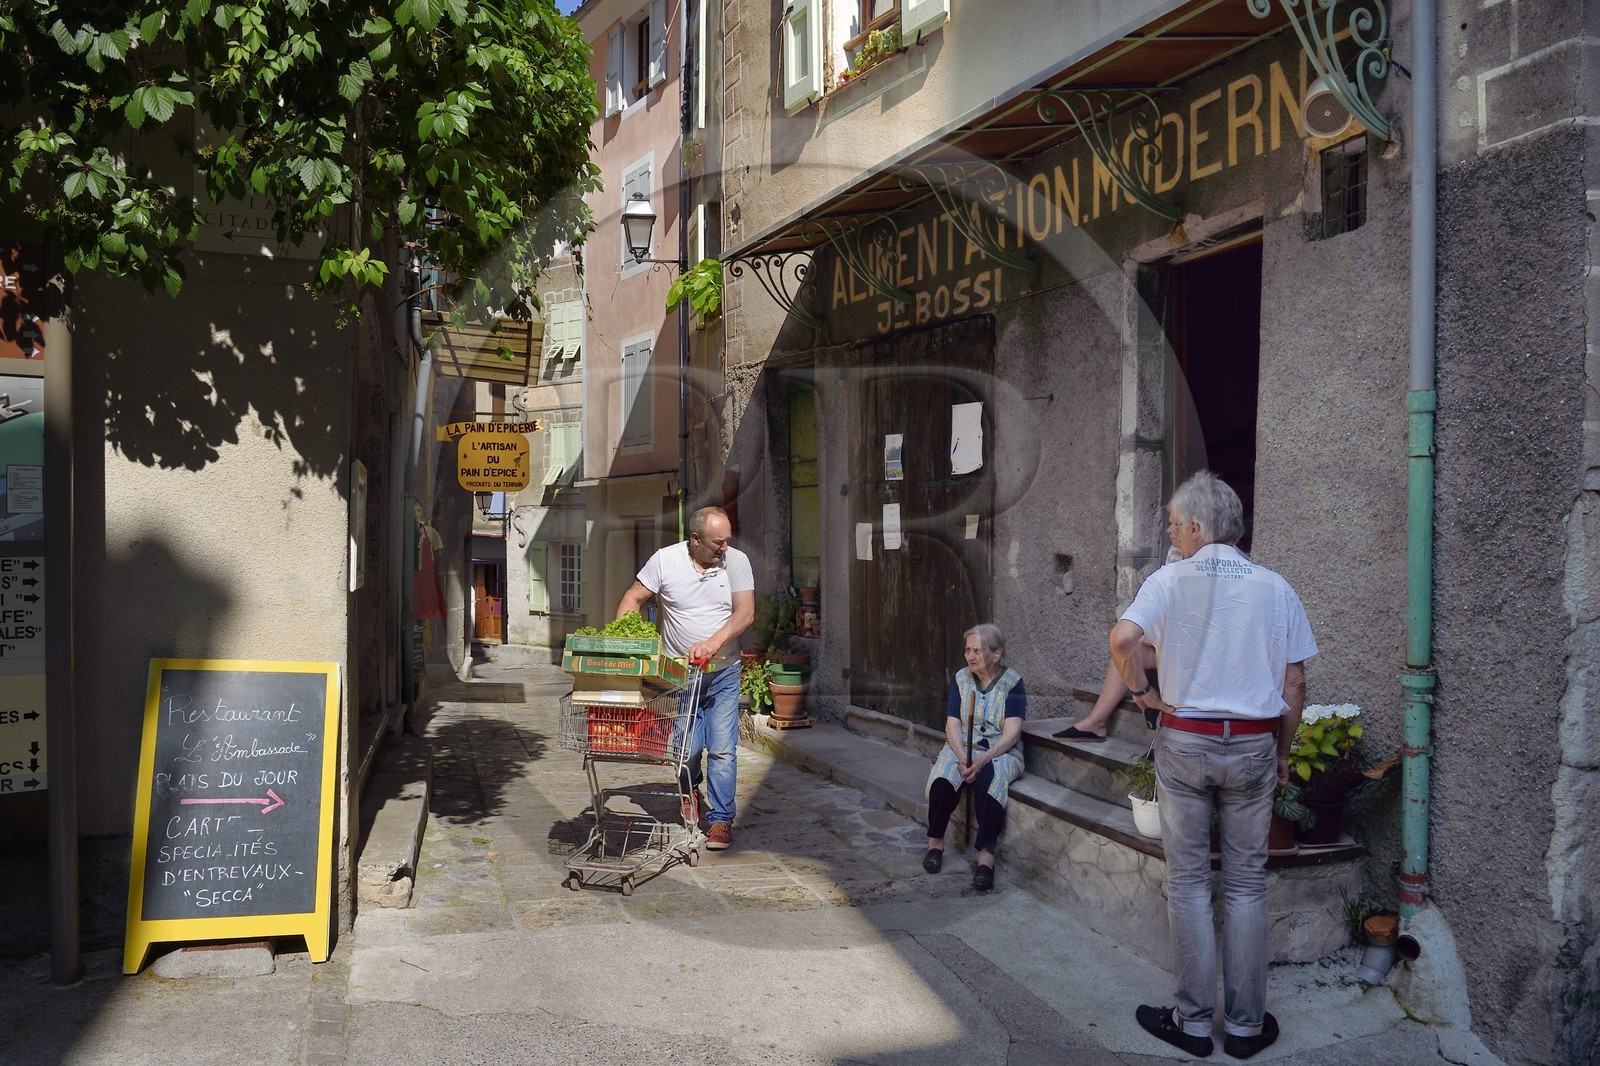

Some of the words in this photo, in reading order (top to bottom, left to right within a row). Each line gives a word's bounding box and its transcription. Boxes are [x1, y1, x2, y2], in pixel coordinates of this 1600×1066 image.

[249, 198, 278, 210] LA
[915, 268, 1003, 325] BOSSI
[446, 424, 461, 436] LA
[465, 423, 485, 433] PAIN
[488, 421, 540, 433] D'EPICERIE
[472, 442, 517, 451] L'ARTISAN
[487, 455, 500, 464] DU
[461, 468, 480, 477] PAIN
[483, 467, 517, 477] D'EPICE
[1205, 557, 1243, 567] KAPORAL
[1195, 564, 1217, 572] DENIM
[1219, 566, 1253, 574] SELECTED
[586, 659, 608, 668] Boule
[608, 660, 616, 668] de
[164, 693, 302, 727] Restaurant
[217, 771, 244, 788] DU
[253, 769, 299, 787] JOUR
